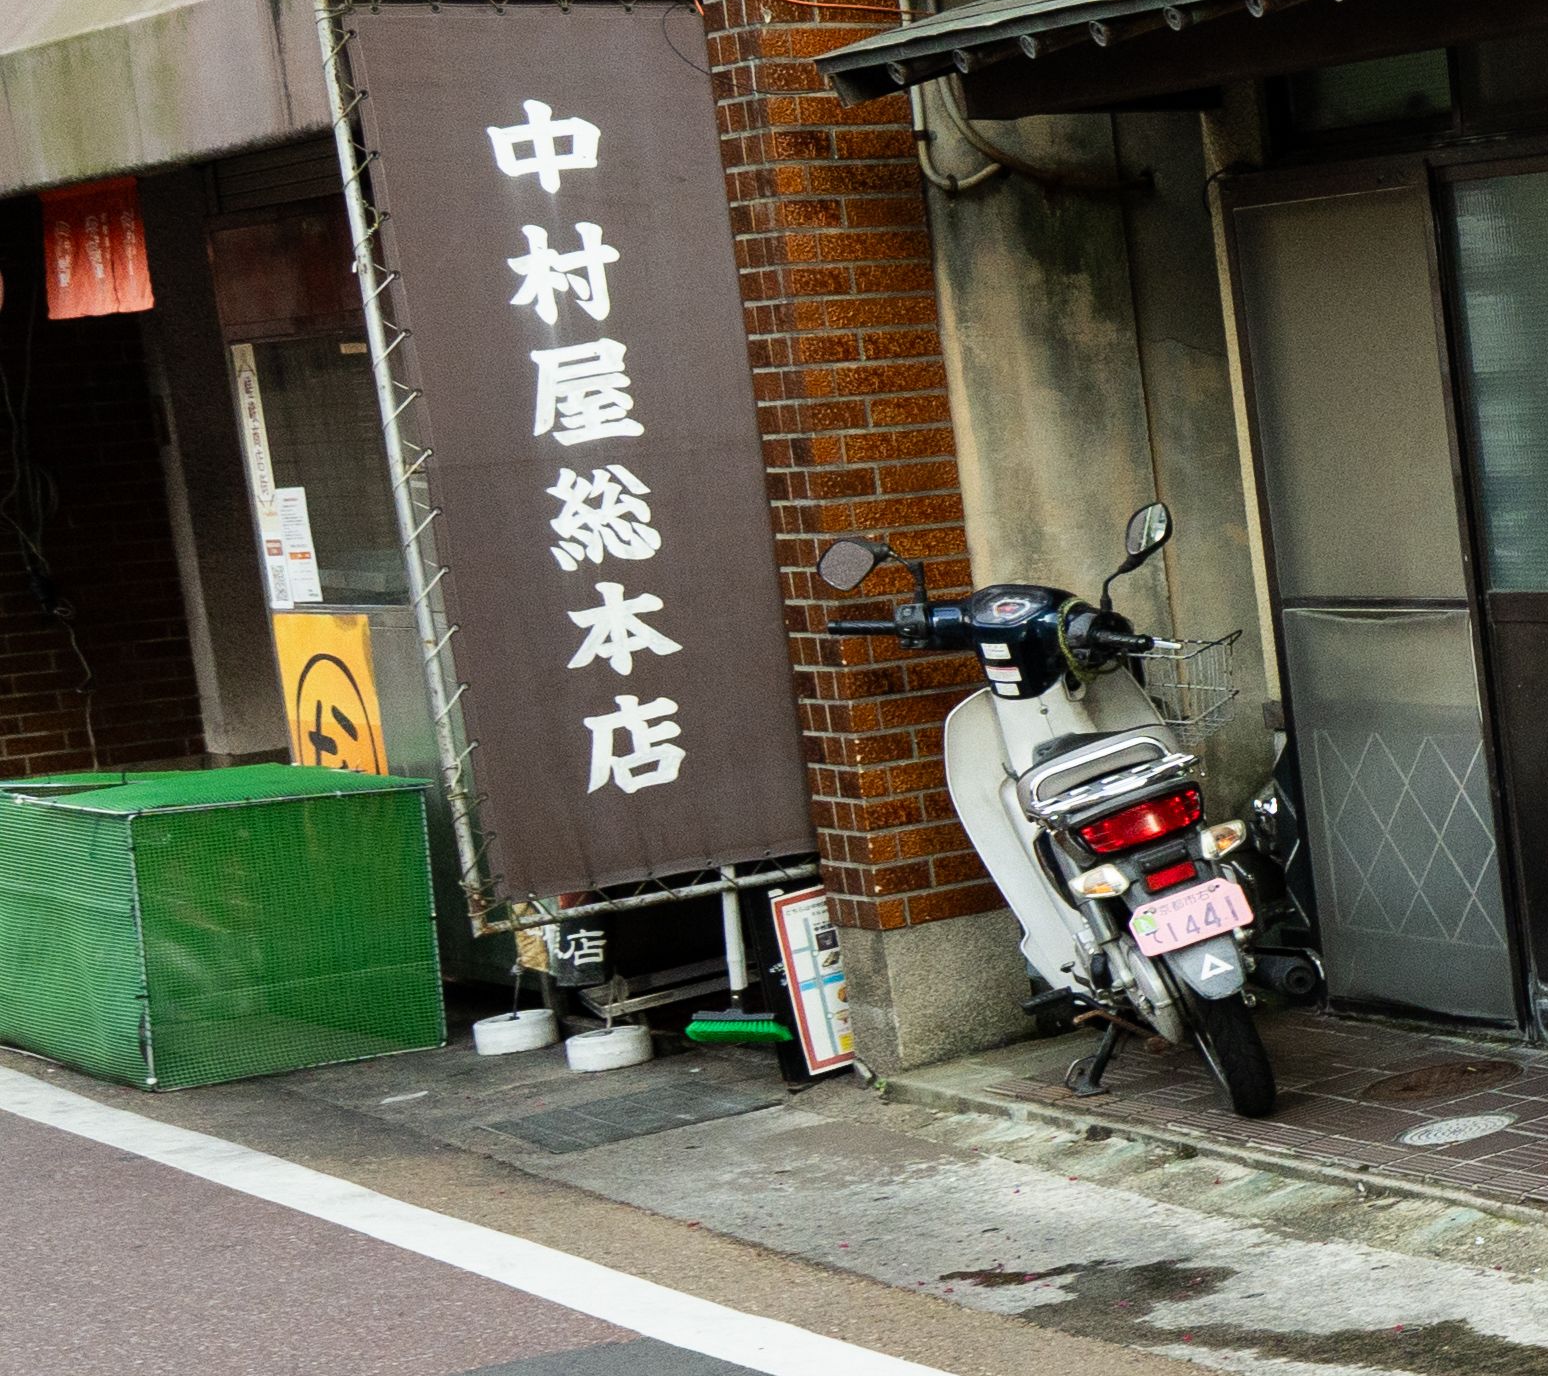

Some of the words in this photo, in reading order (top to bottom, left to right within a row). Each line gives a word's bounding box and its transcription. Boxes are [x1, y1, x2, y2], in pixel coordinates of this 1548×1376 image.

[486, 99, 687, 796] 中村屋総本店
